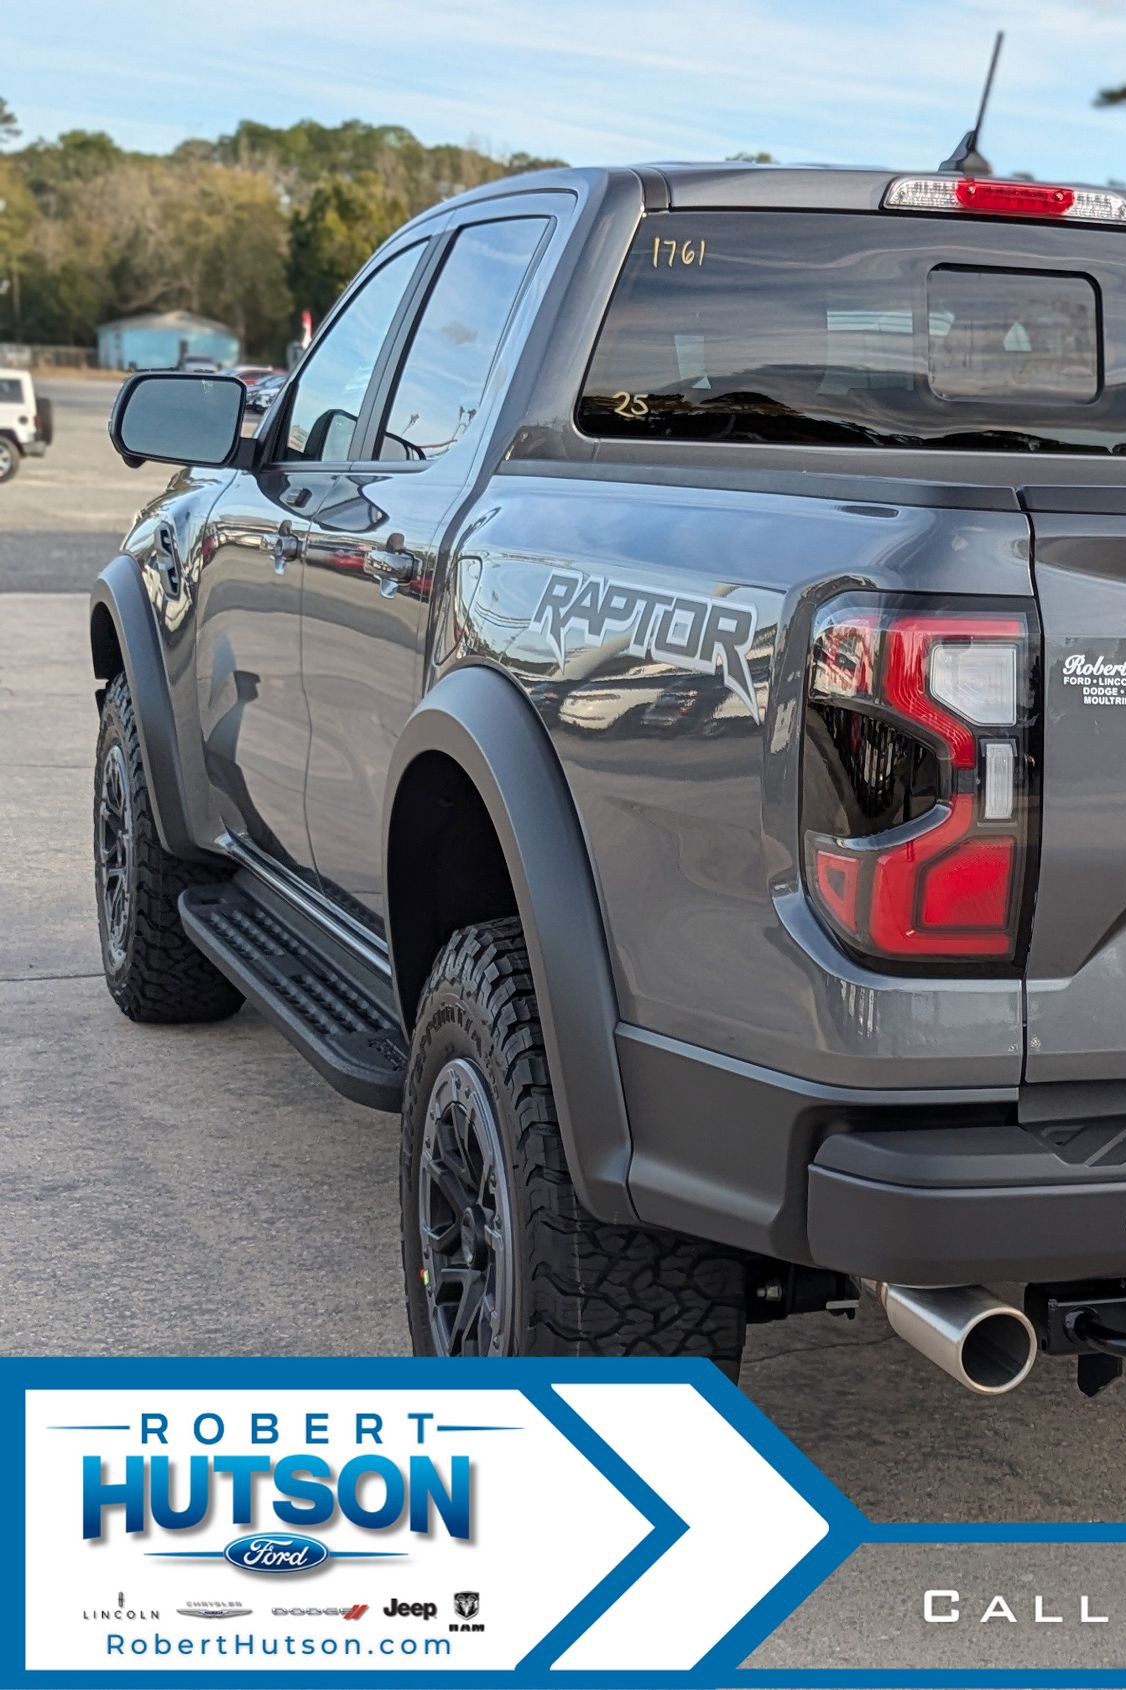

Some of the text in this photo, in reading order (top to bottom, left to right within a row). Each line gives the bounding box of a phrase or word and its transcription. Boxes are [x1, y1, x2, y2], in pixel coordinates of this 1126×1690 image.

[652, 236, 706, 268] 1761
[612, 390, 650, 418] 25
[529, 567, 760, 727] RAPTOR
[1063, 676, 1092, 686] FORD
[1082, 687, 1118, 696] DODGE
